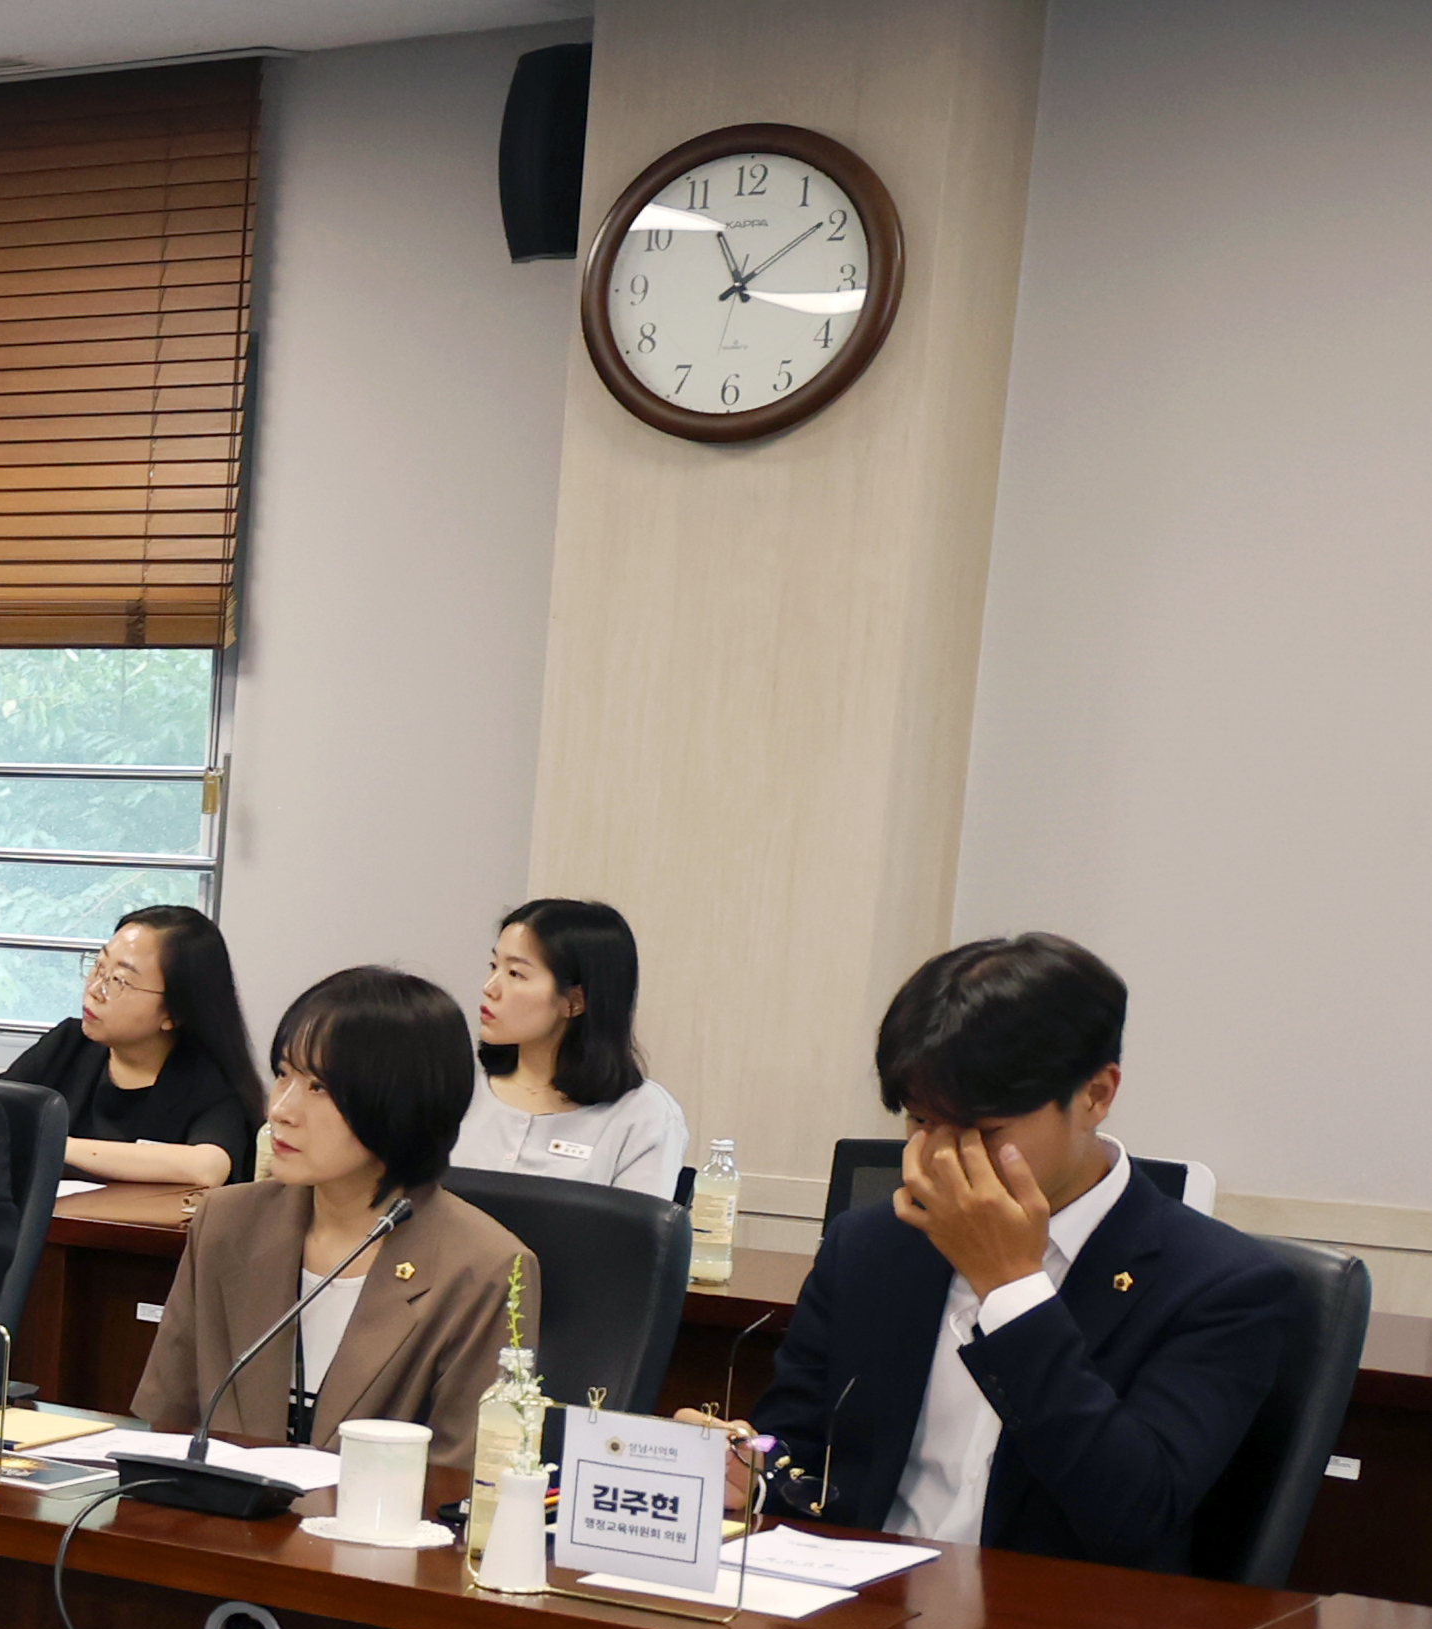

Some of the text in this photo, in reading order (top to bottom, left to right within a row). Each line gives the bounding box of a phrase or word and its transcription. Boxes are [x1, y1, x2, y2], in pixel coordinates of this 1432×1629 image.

[686, 178, 710, 210] 11
[734, 162, 769, 197] 12
[798, 175, 810, 208] 1
[826, 208, 848, 242] 2
[629, 274, 650, 306] 9
[836, 263, 857, 293] 3
[637, 322, 657, 354] 8
[813, 318, 833, 349] 4
[673, 364, 692, 395] 7
[720, 374, 740, 406] 6
[772, 360, 793, 392] 5
[628, 1442, 678, 1457] 성남시의회
[592, 1484, 680, 1522] 김주현
[584, 1516, 687, 1544] 행정교육위원회 의원
